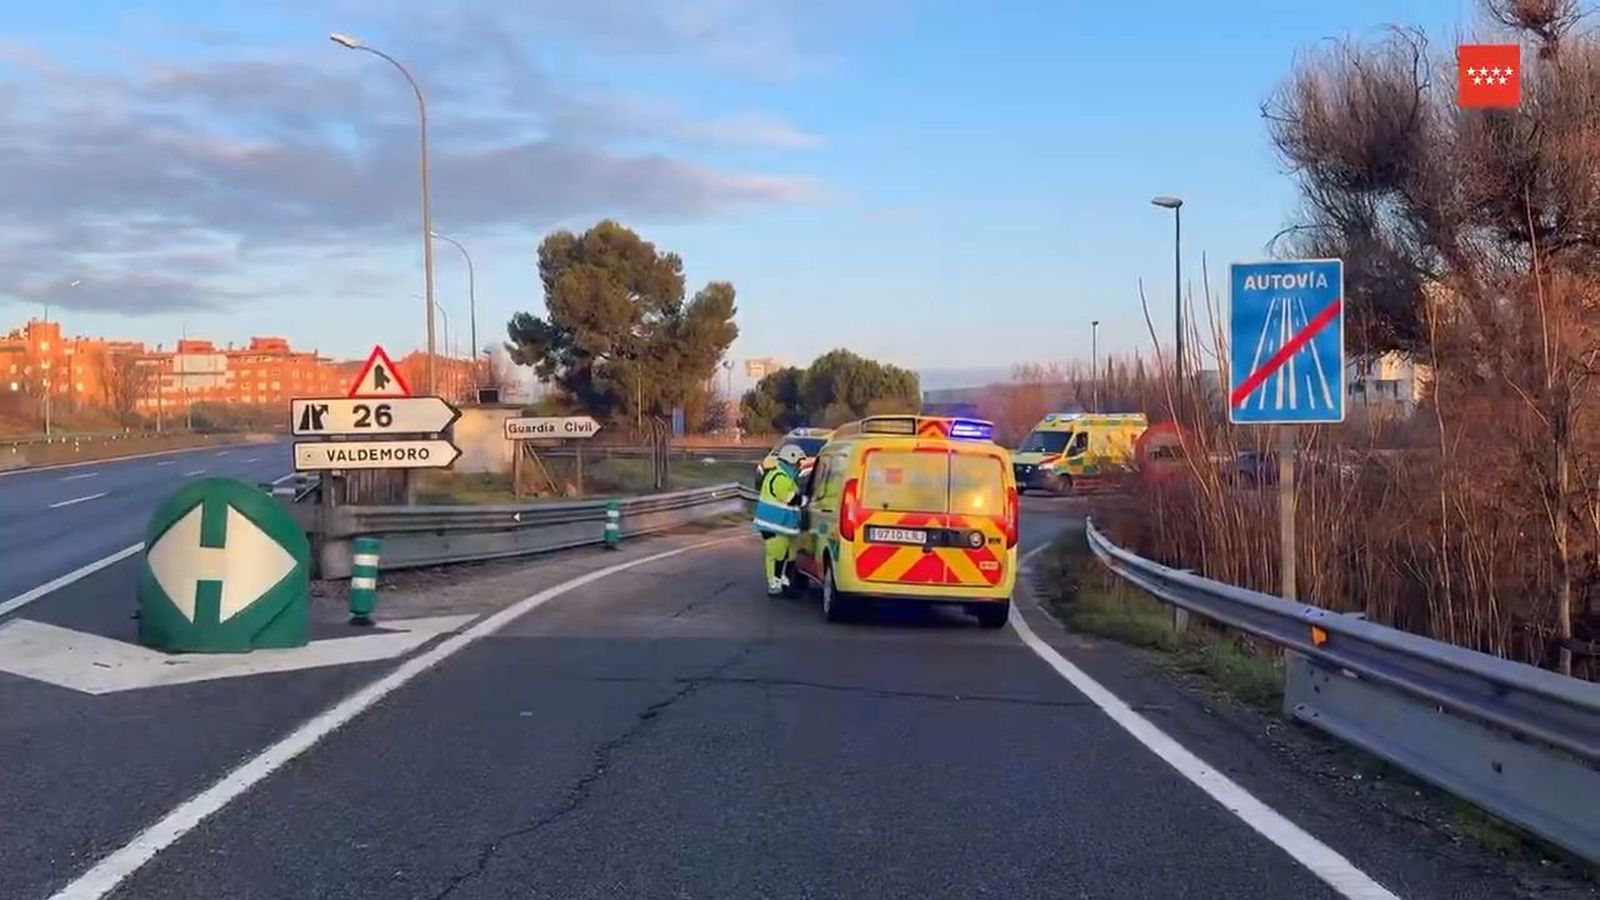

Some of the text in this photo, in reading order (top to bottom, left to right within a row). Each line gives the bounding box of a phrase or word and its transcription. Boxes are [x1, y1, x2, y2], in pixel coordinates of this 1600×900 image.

[352, 404, 393, 428] 26
[508, 421, 592, 433] Guardia Civil
[326, 448, 430, 462] VALDEMORO
